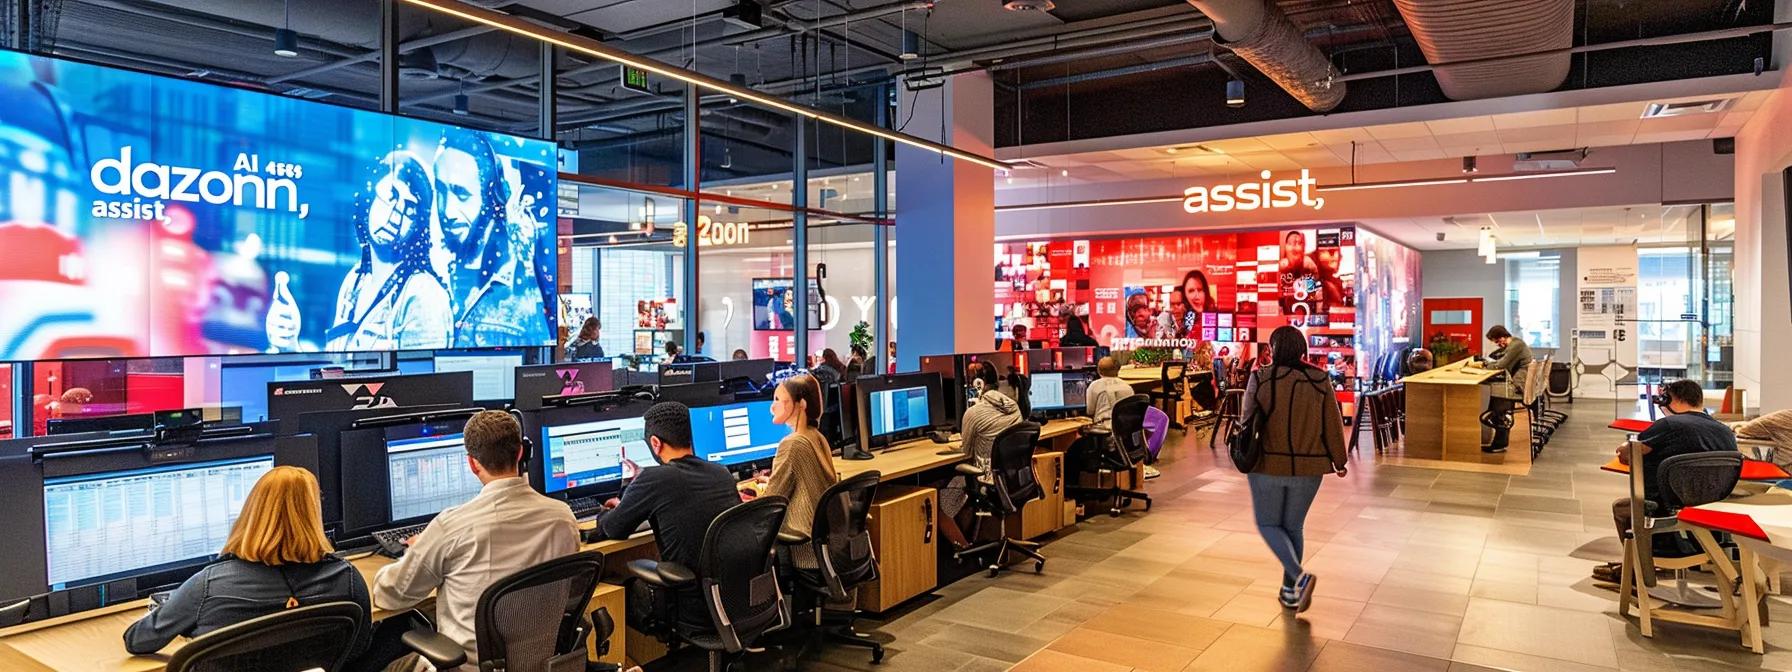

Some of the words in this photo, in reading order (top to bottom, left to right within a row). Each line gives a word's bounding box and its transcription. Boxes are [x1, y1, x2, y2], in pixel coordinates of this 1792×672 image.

[233, 152, 259, 173] AI
[91, 146, 309, 219] dazonn,
[1183, 168, 1325, 214] assist,
[91, 198, 172, 225] assist,
